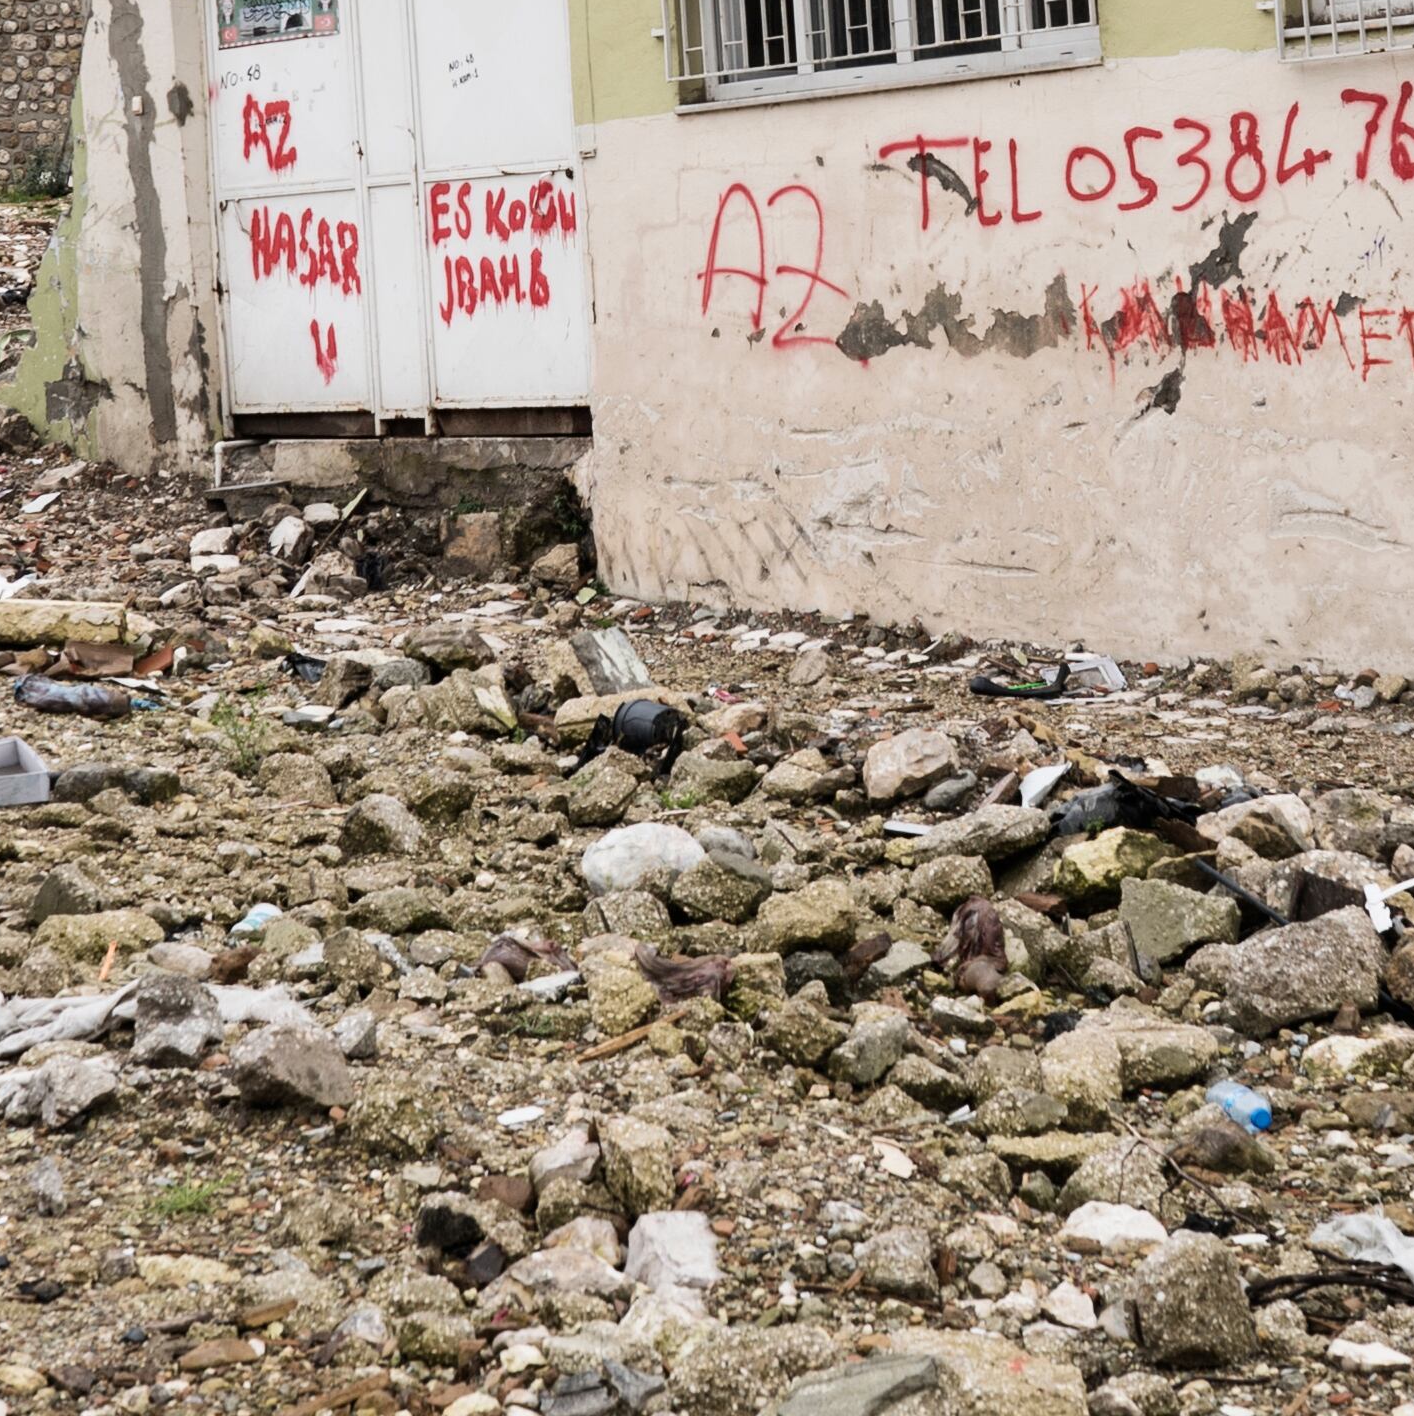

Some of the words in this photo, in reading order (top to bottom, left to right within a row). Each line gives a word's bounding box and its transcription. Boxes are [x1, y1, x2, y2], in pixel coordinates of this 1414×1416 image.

[242, 93, 296, 173] AZ
[430, 182, 472, 245] ES
[879, 134, 1043, 231] TEL
[251, 205, 362, 297] HASAR
